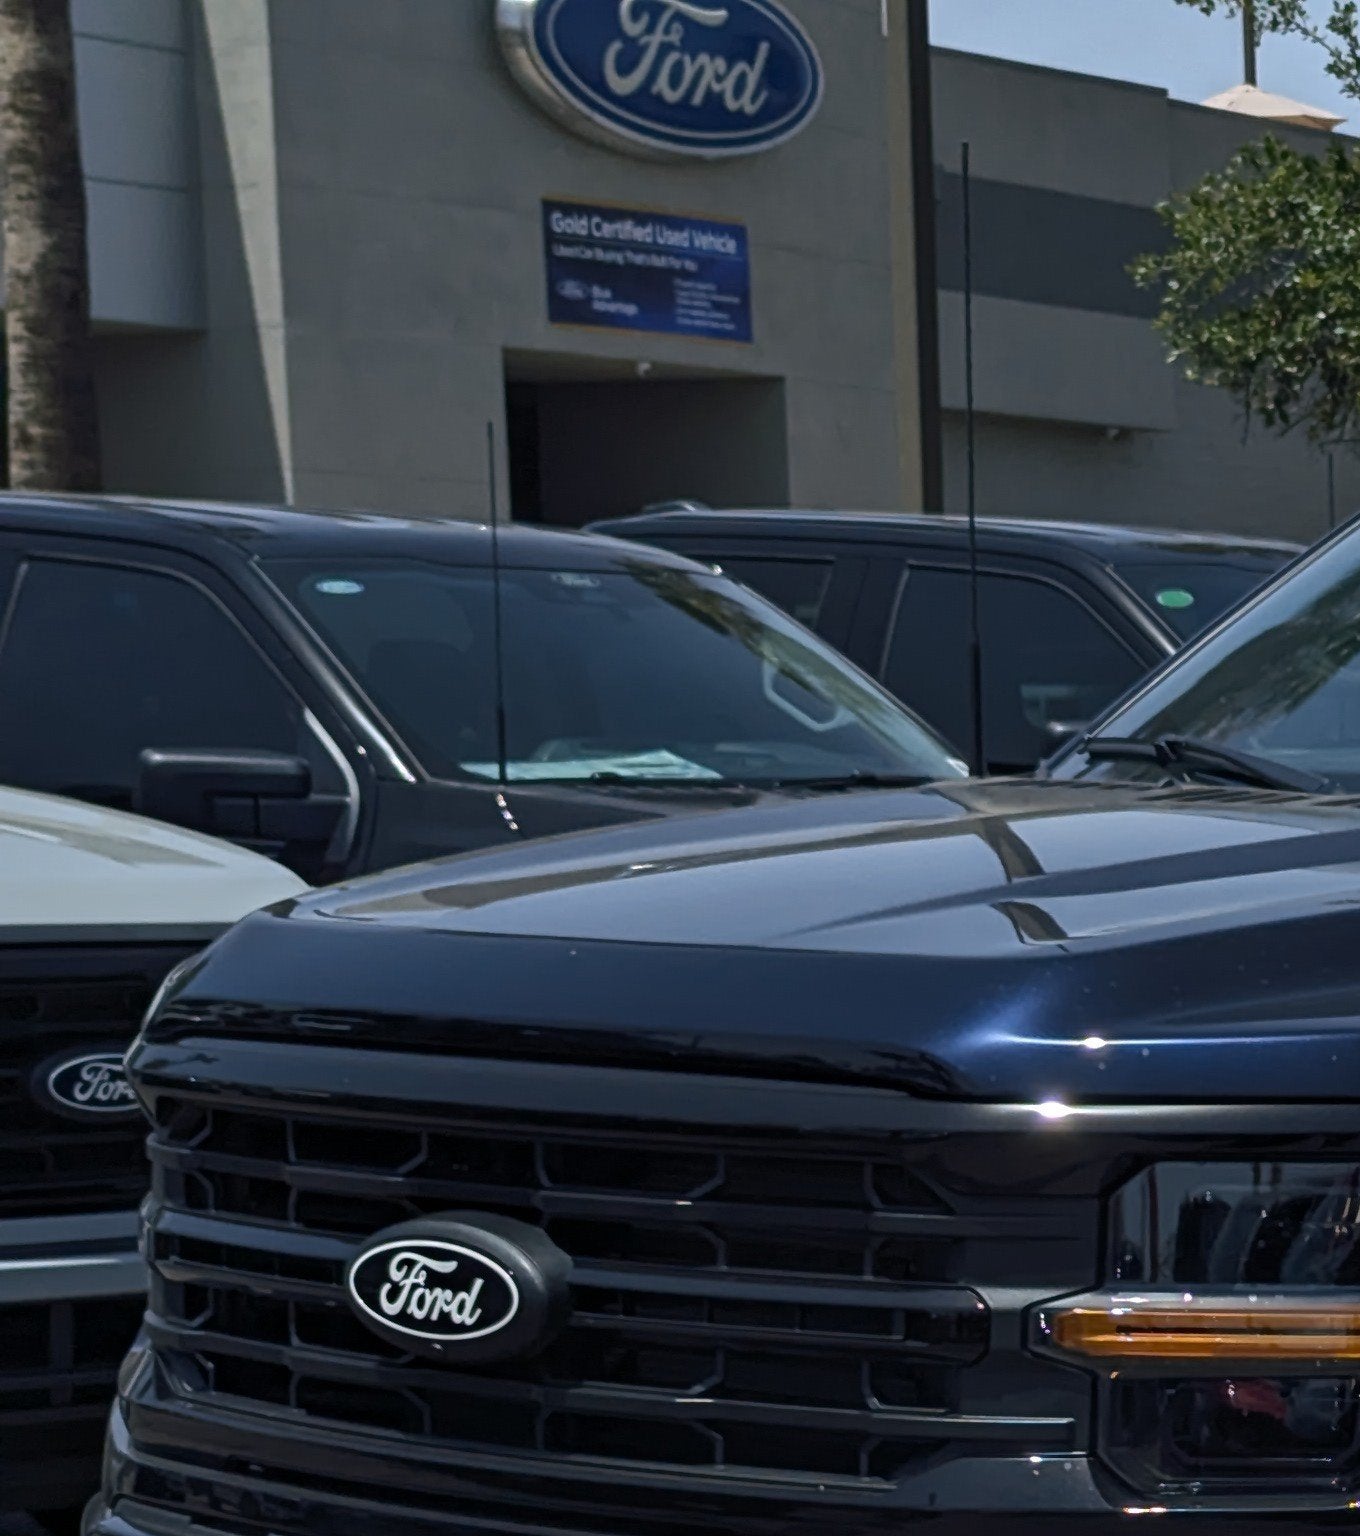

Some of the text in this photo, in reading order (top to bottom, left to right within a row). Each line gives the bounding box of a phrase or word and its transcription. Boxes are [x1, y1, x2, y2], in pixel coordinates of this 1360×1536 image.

[604, 0, 770, 115] Ford
[551, 211, 738, 255] Gold Certified Used Vehicle
[73, 1062, 137, 1102] For
[378, 1251, 484, 1327] Ford
